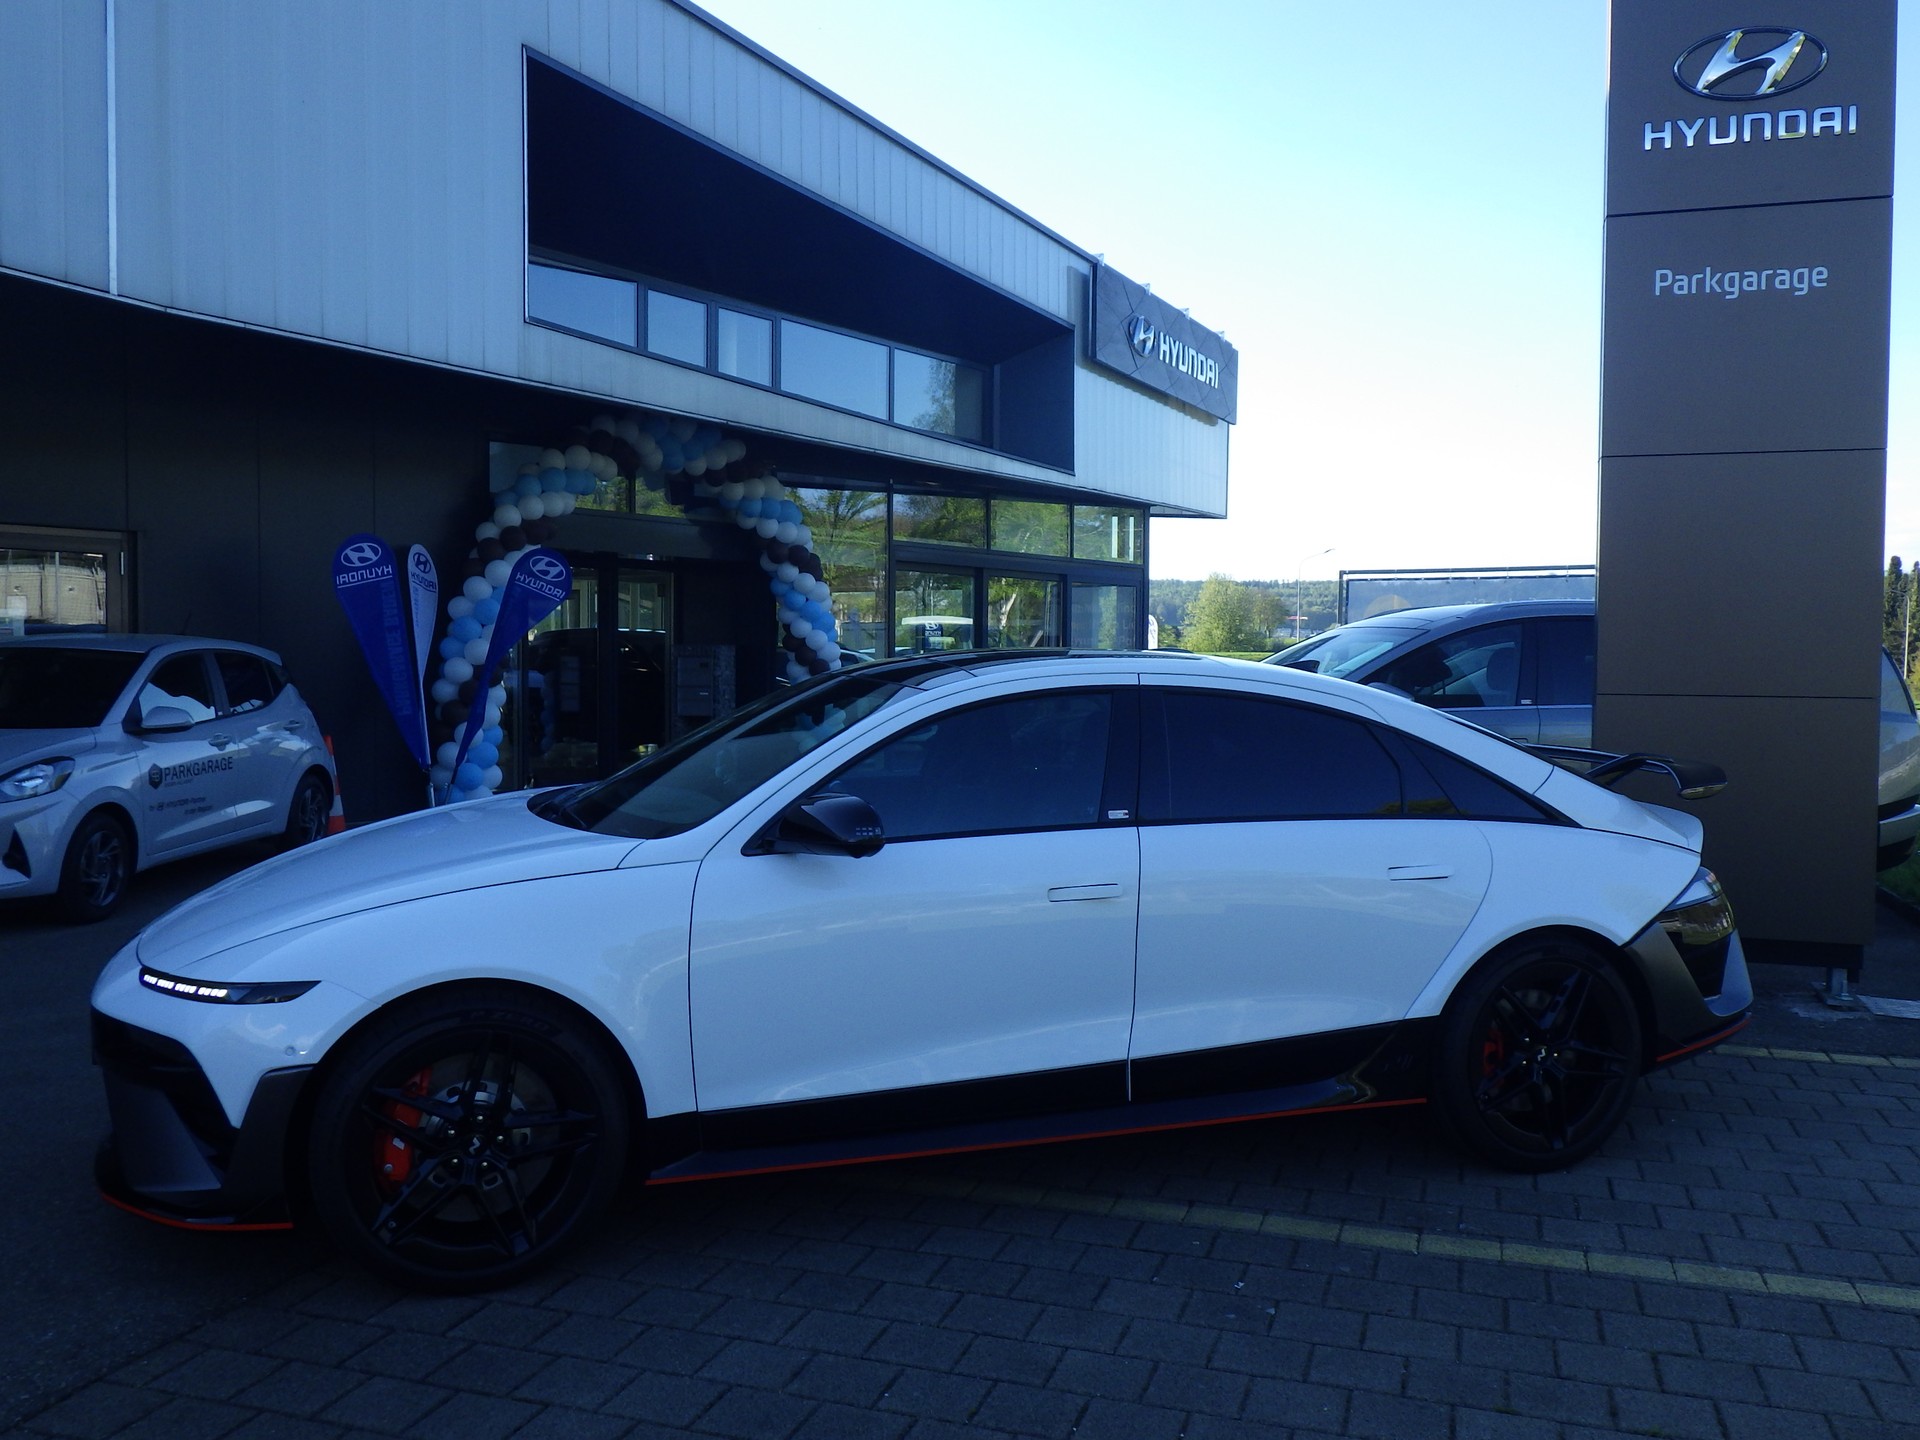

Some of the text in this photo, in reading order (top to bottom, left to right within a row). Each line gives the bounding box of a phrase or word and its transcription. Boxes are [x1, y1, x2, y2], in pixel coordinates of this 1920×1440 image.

[1643, 104, 1858, 151] HYUNDAI
[1654, 266, 1829, 300] Parkgarage
[1158, 331, 1220, 389] HYUNDAI
[514, 571, 566, 599] HYUNDAI
[164, 756, 233, 781] PARKGARAGE
